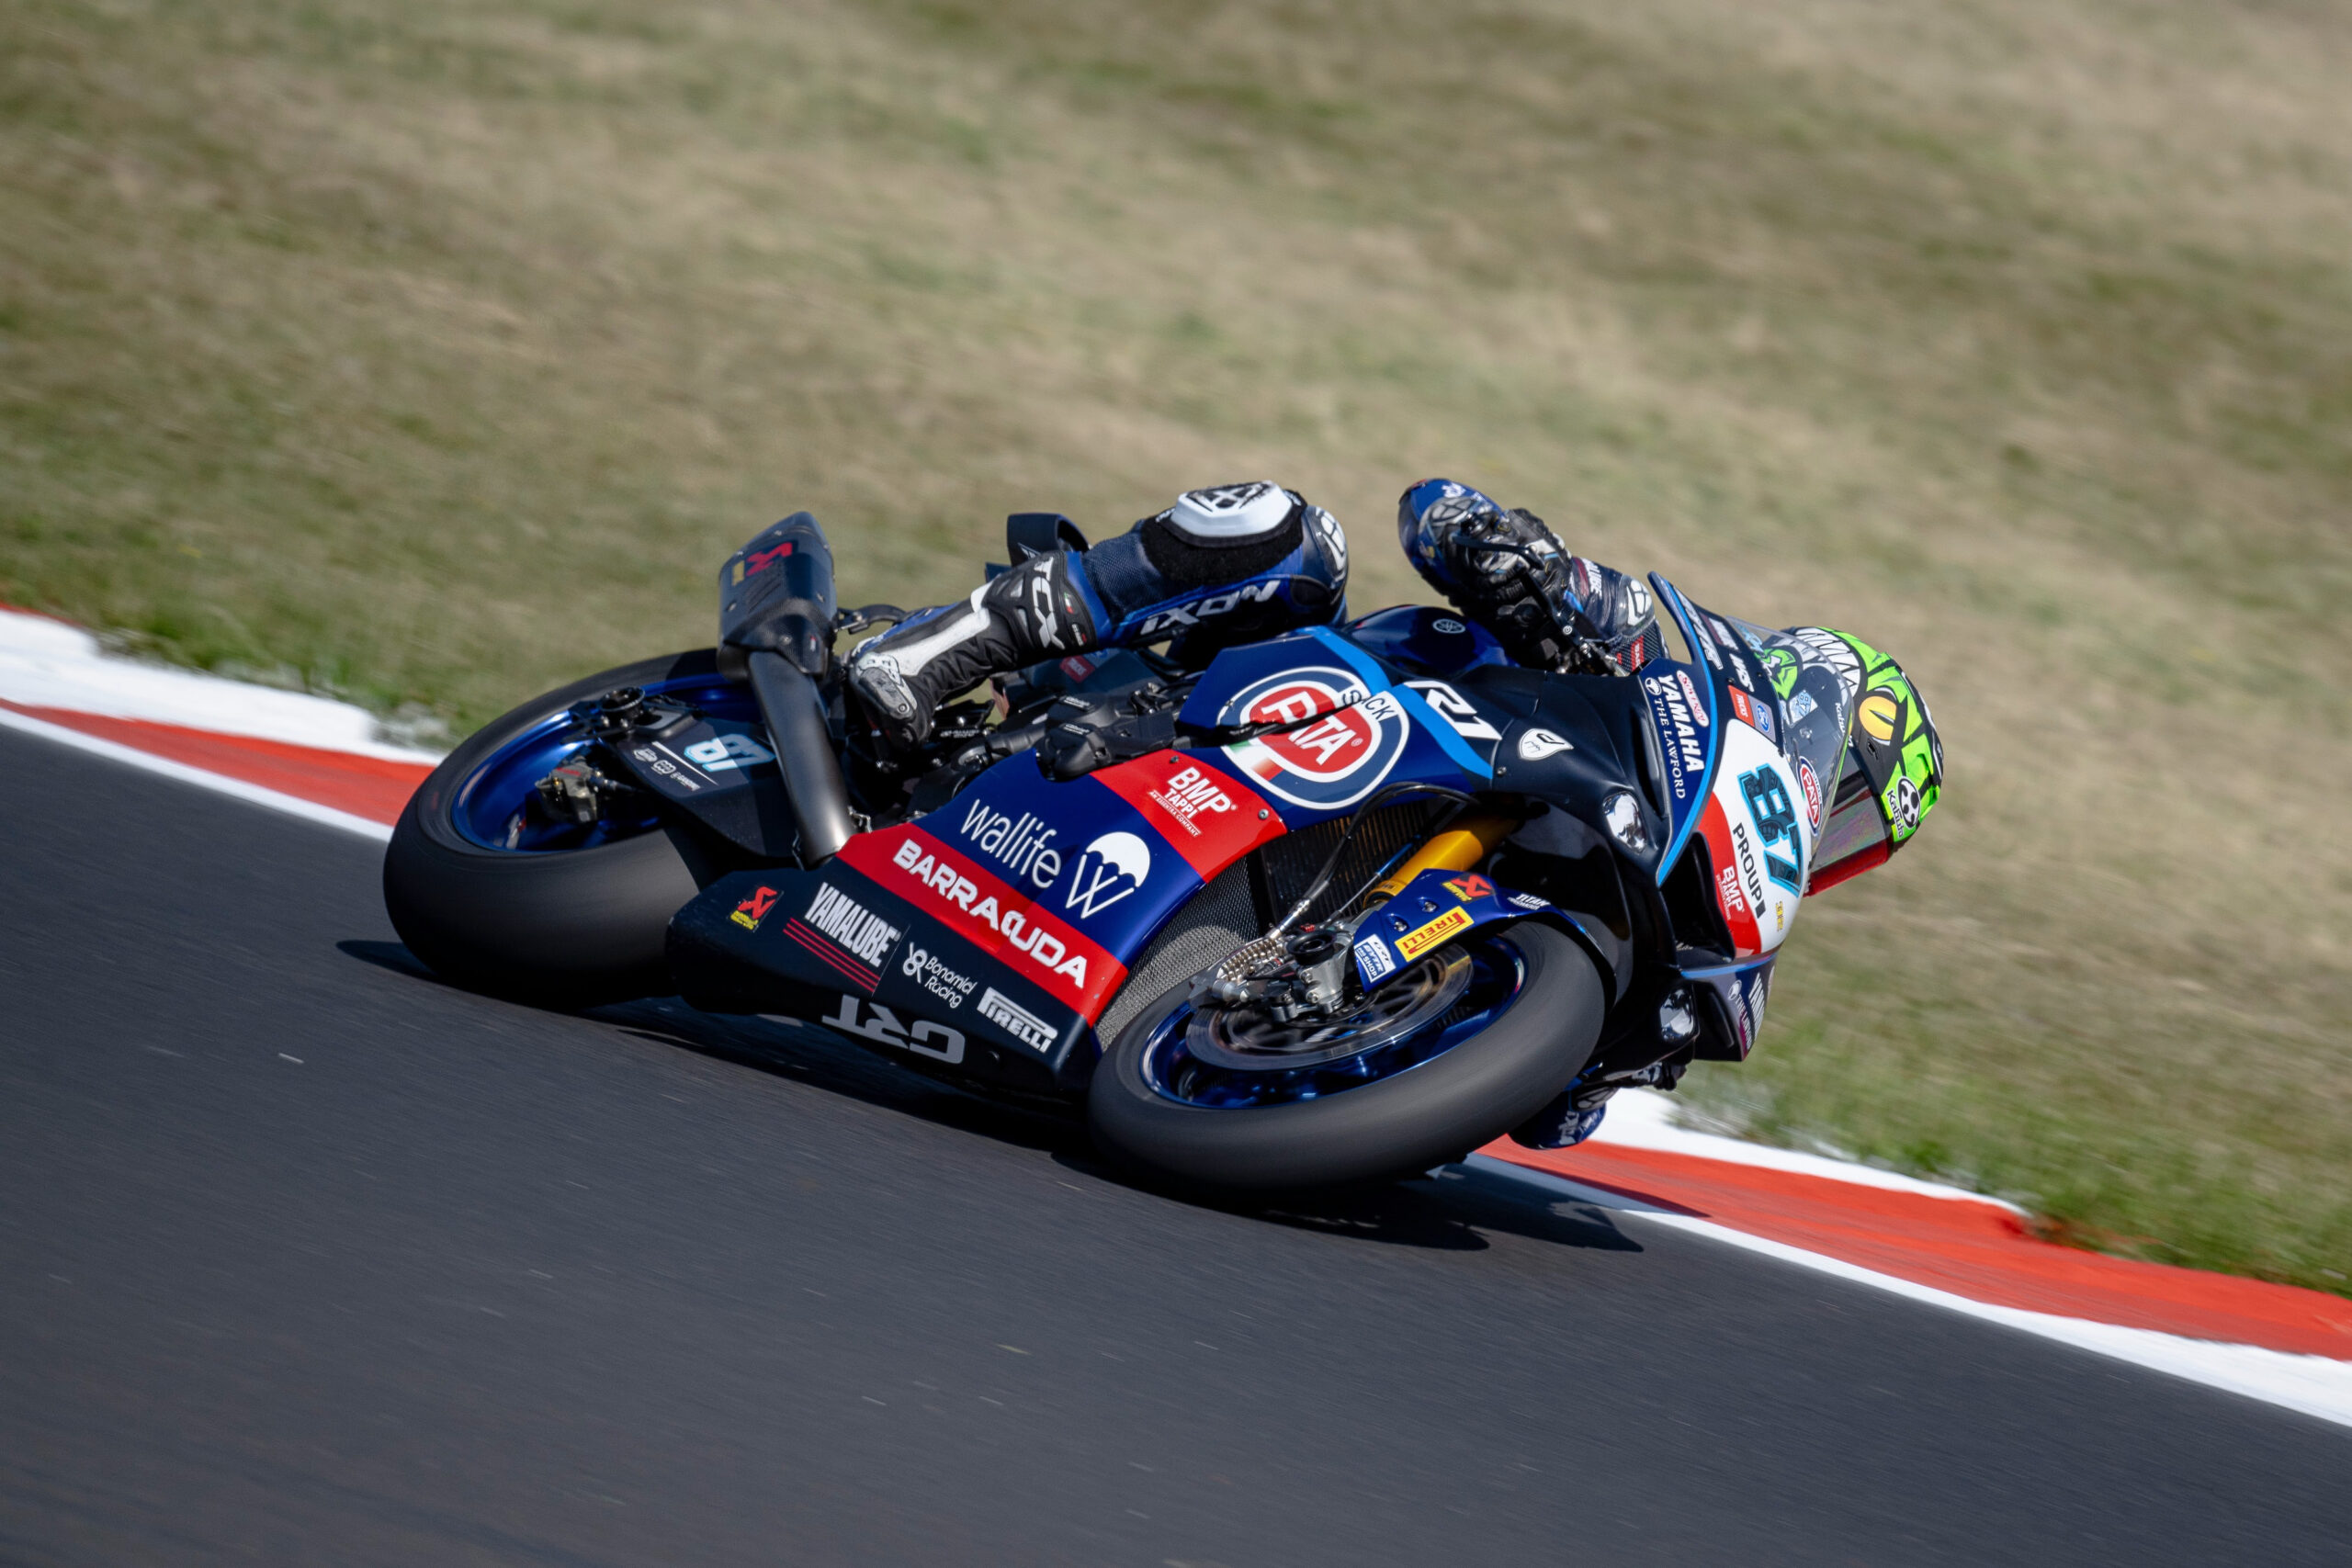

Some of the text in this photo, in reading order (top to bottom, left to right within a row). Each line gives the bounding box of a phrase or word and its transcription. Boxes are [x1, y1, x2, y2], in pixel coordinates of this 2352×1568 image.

[1032, 557, 1066, 650] TCX
[1654, 698, 1687, 799] THE LAWFORD
[1658, 674, 1705, 772] YAMAHA
[1164, 787, 1198, 819] TAPPI
[1167, 766, 1232, 813] BMP
[1803, 771, 1819, 825] PATA
[961, 798, 1062, 889] wallife
[1174, 813, 1199, 837] COMPANY
[1736, 762, 1804, 898] 87
[1723, 865, 1744, 913] BMP
[1733, 822, 1763, 902] PROUP
[805, 882, 897, 969] YAMALUBE
[892, 839, 1086, 989] BARRACUDA
[1401, 911, 1467, 955] PIRELLI
[924, 976, 964, 1010] Racing
[1363, 956, 1378, 976] SHOP
[820, 993, 967, 1065] GRT
[976, 986, 1058, 1054] PIRELLI
